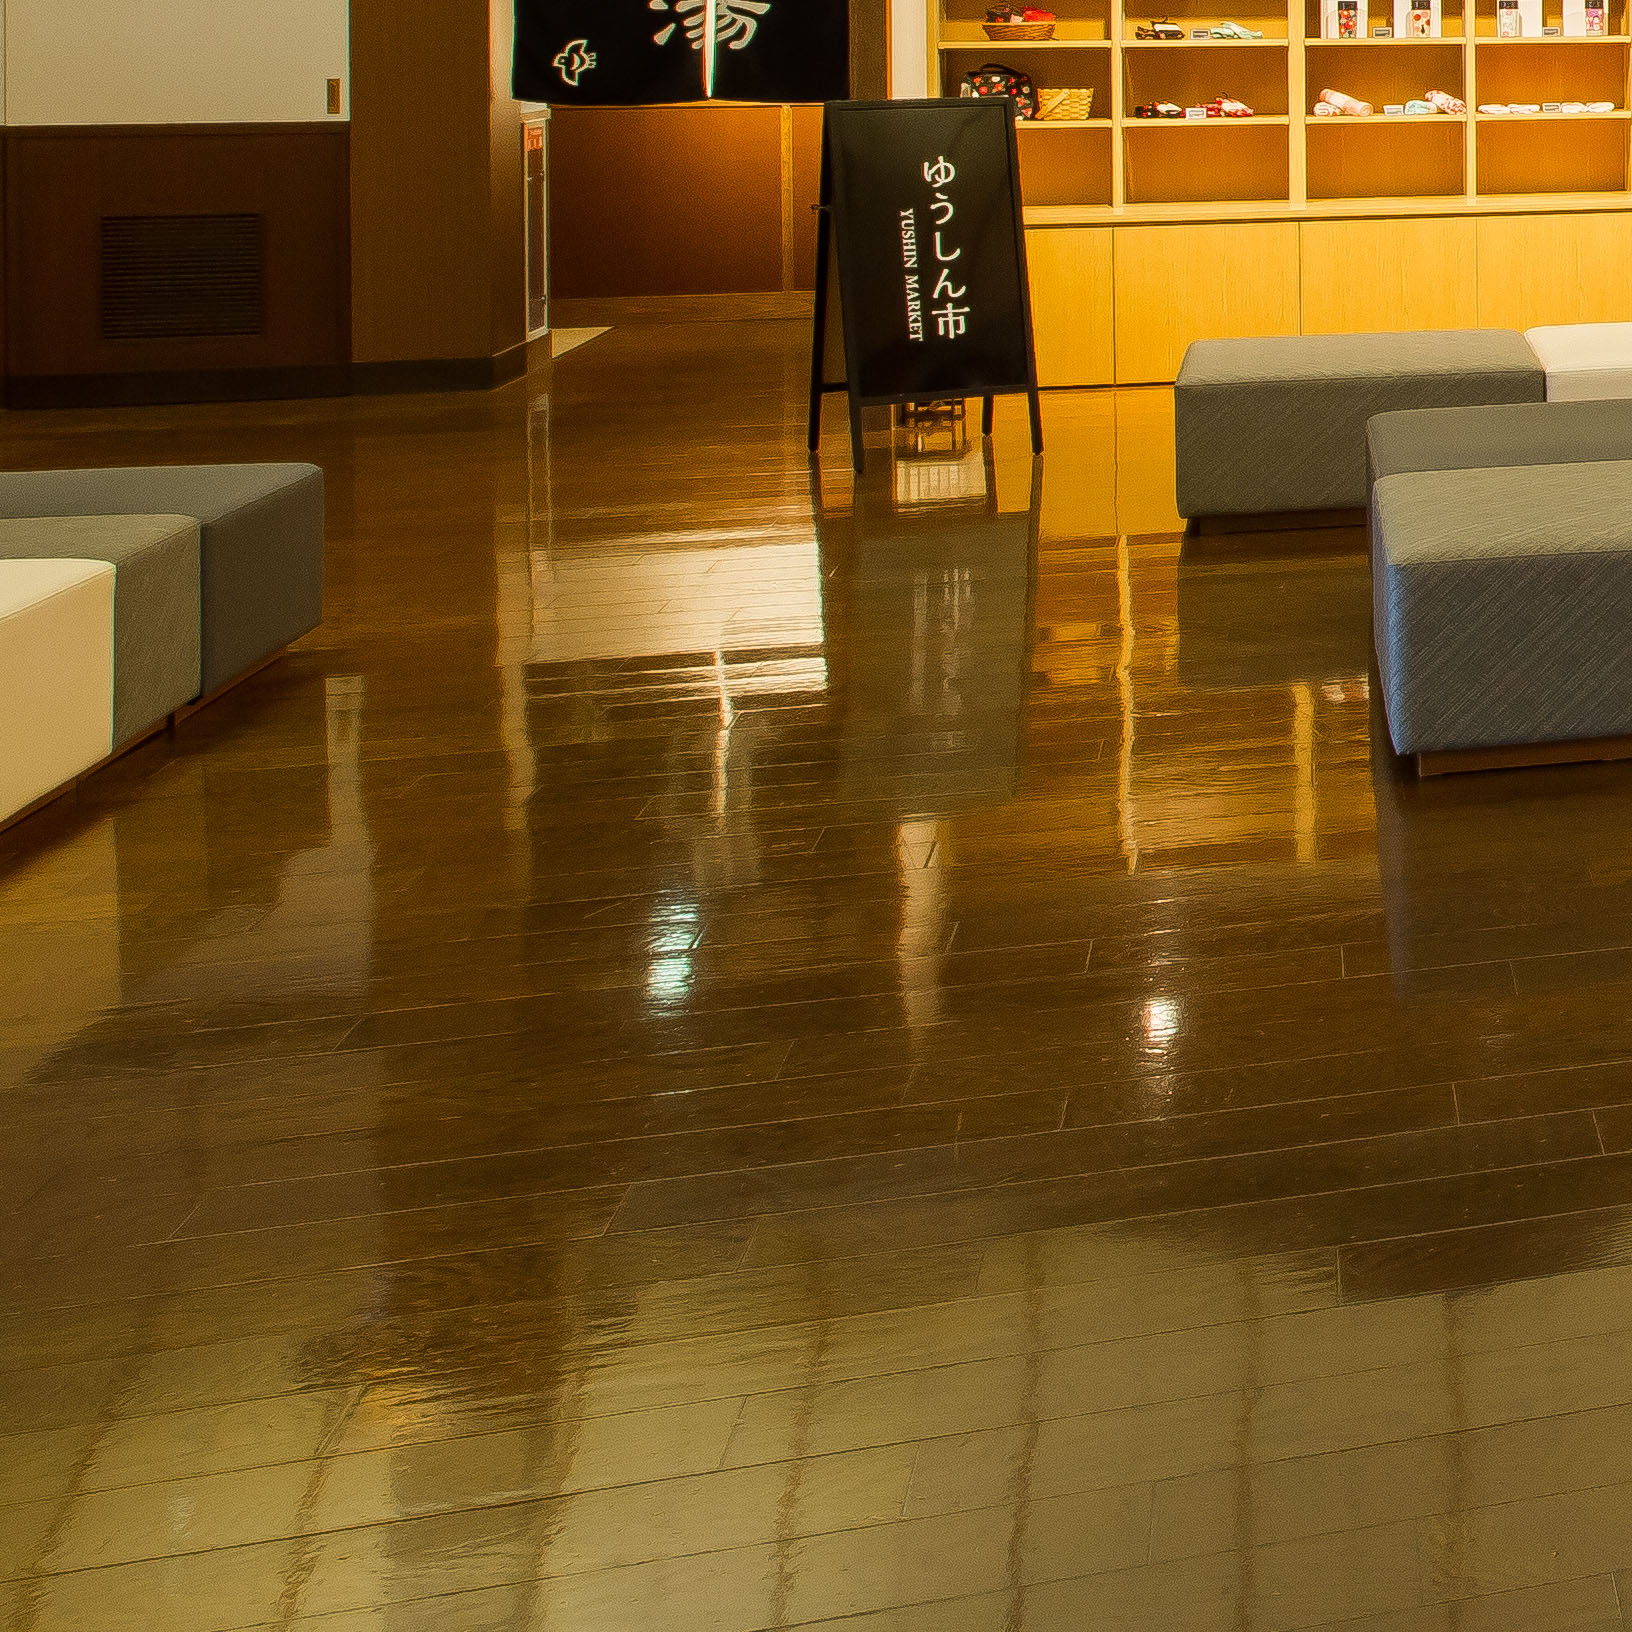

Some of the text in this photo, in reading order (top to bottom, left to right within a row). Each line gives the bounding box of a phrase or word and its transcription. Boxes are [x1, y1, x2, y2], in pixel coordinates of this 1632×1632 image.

[900, 207, 923, 342] YUSHIN MARKET
[921, 155, 971, 339] ゆうしん市
